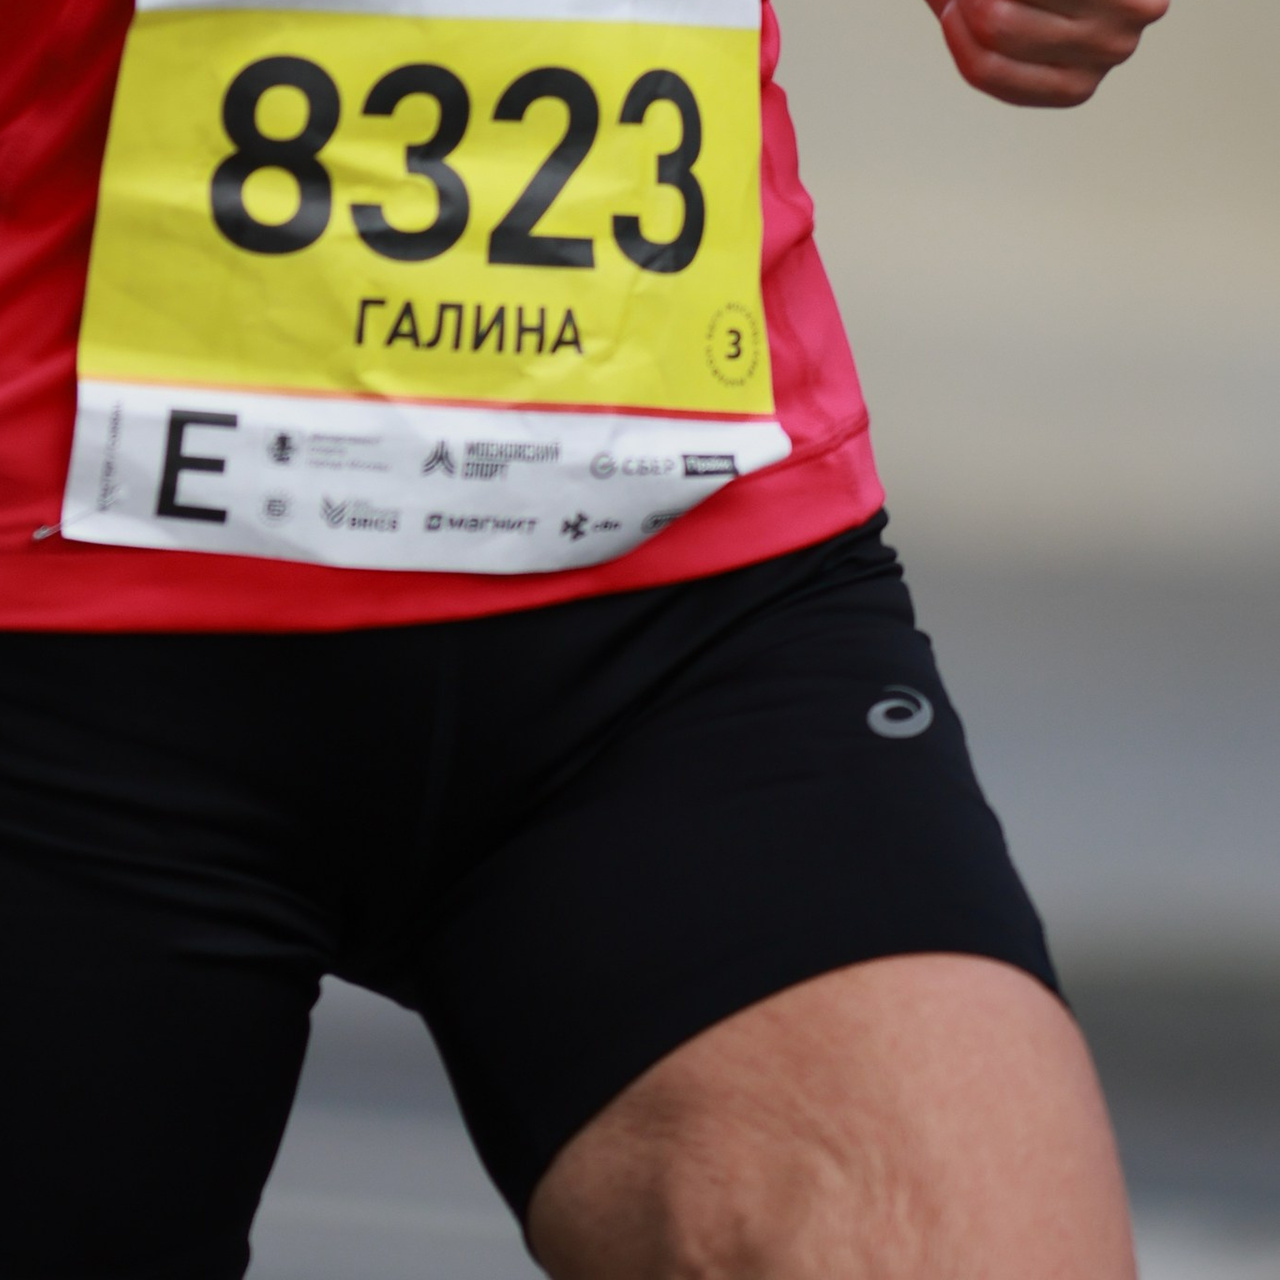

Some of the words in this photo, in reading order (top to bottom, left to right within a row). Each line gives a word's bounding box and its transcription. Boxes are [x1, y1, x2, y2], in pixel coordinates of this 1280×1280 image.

[210, 54, 706, 275] 8323
[354, 297, 584, 355] ГАЛИНА
[724, 328, 742, 360] 3
[156, 409, 238, 524] E
